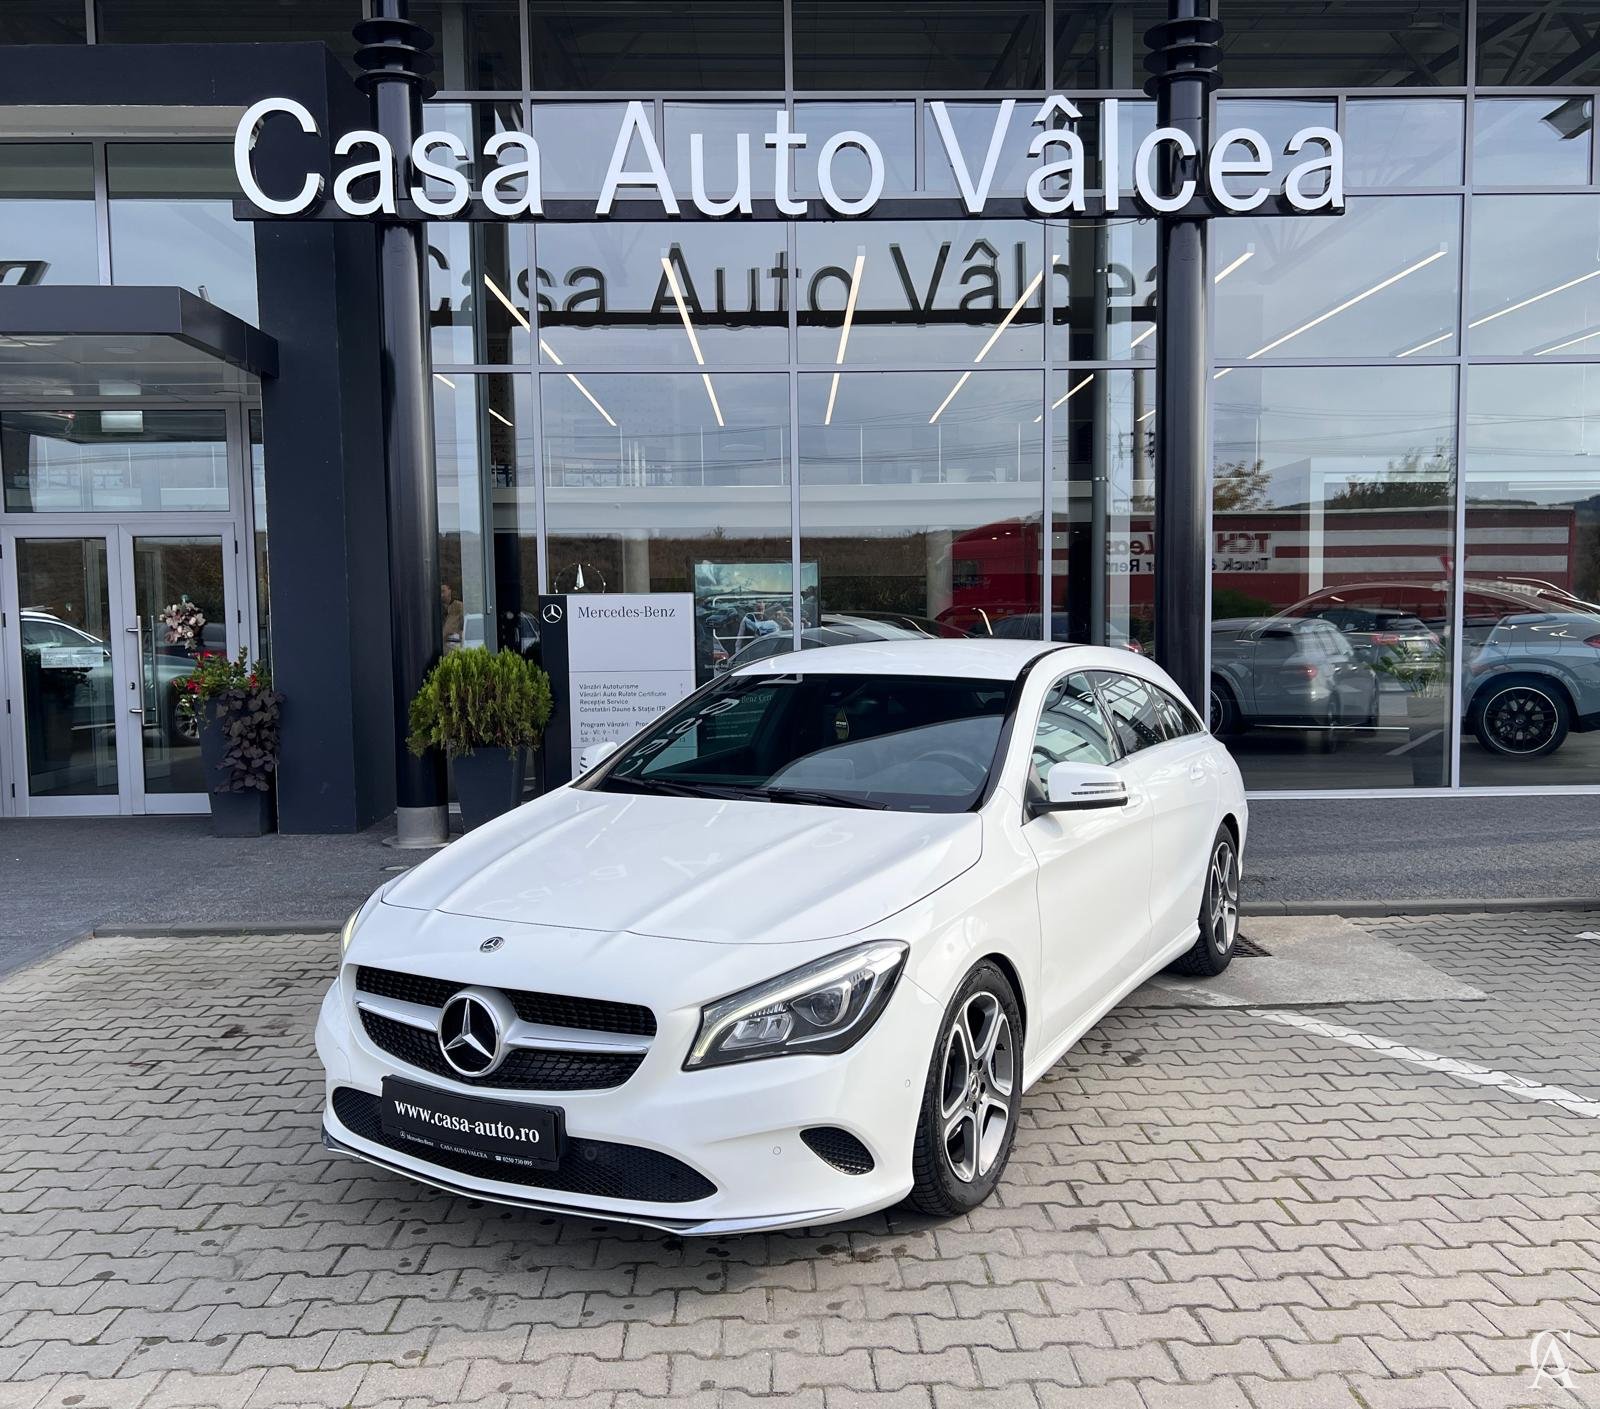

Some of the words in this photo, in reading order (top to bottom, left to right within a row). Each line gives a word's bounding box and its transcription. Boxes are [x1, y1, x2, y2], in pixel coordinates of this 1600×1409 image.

[233, 97, 544, 216] Casa
[595, 100, 885, 216] Auto
[929, 94, 1346, 214] Vâlcea
[578, 605, 676, 620] Mercedes-Benz
[394, 1100, 540, 1143] www.casa-auto.ro
